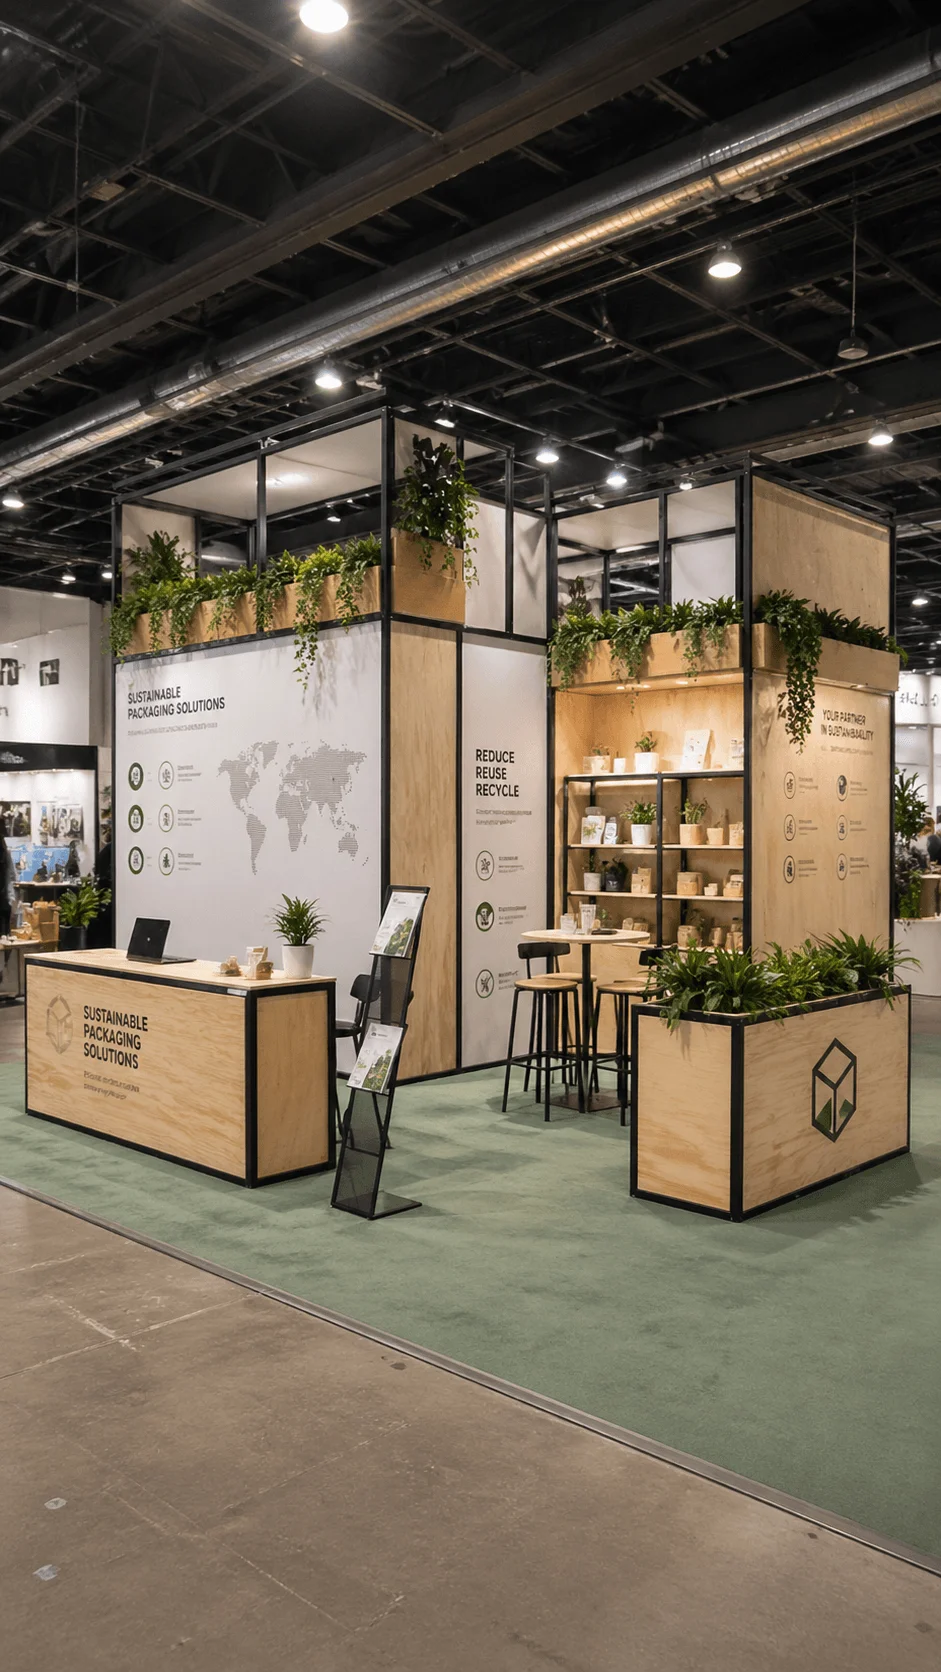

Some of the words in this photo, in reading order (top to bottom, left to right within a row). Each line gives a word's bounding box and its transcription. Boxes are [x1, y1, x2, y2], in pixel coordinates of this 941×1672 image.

[128, 686, 181, 704] SUSTAINABLE
[128, 703, 175, 720] PACKAGING
[176, 697, 225, 714] SOLUTIONS
[823, 709, 839, 722] YOUR
[840, 711, 866, 726] PARTNER
[821, 724, 828, 735] IN
[476, 749, 515, 764] REDUCE
[476, 766, 507, 780] REUSE
[476, 783, 520, 797] RECYCLE
[84, 1005, 148, 1032] SUSTAINABLE
[84, 1023, 141, 1050] PACKAGING
[84, 1042, 139, 1069] SOLUTIONS
